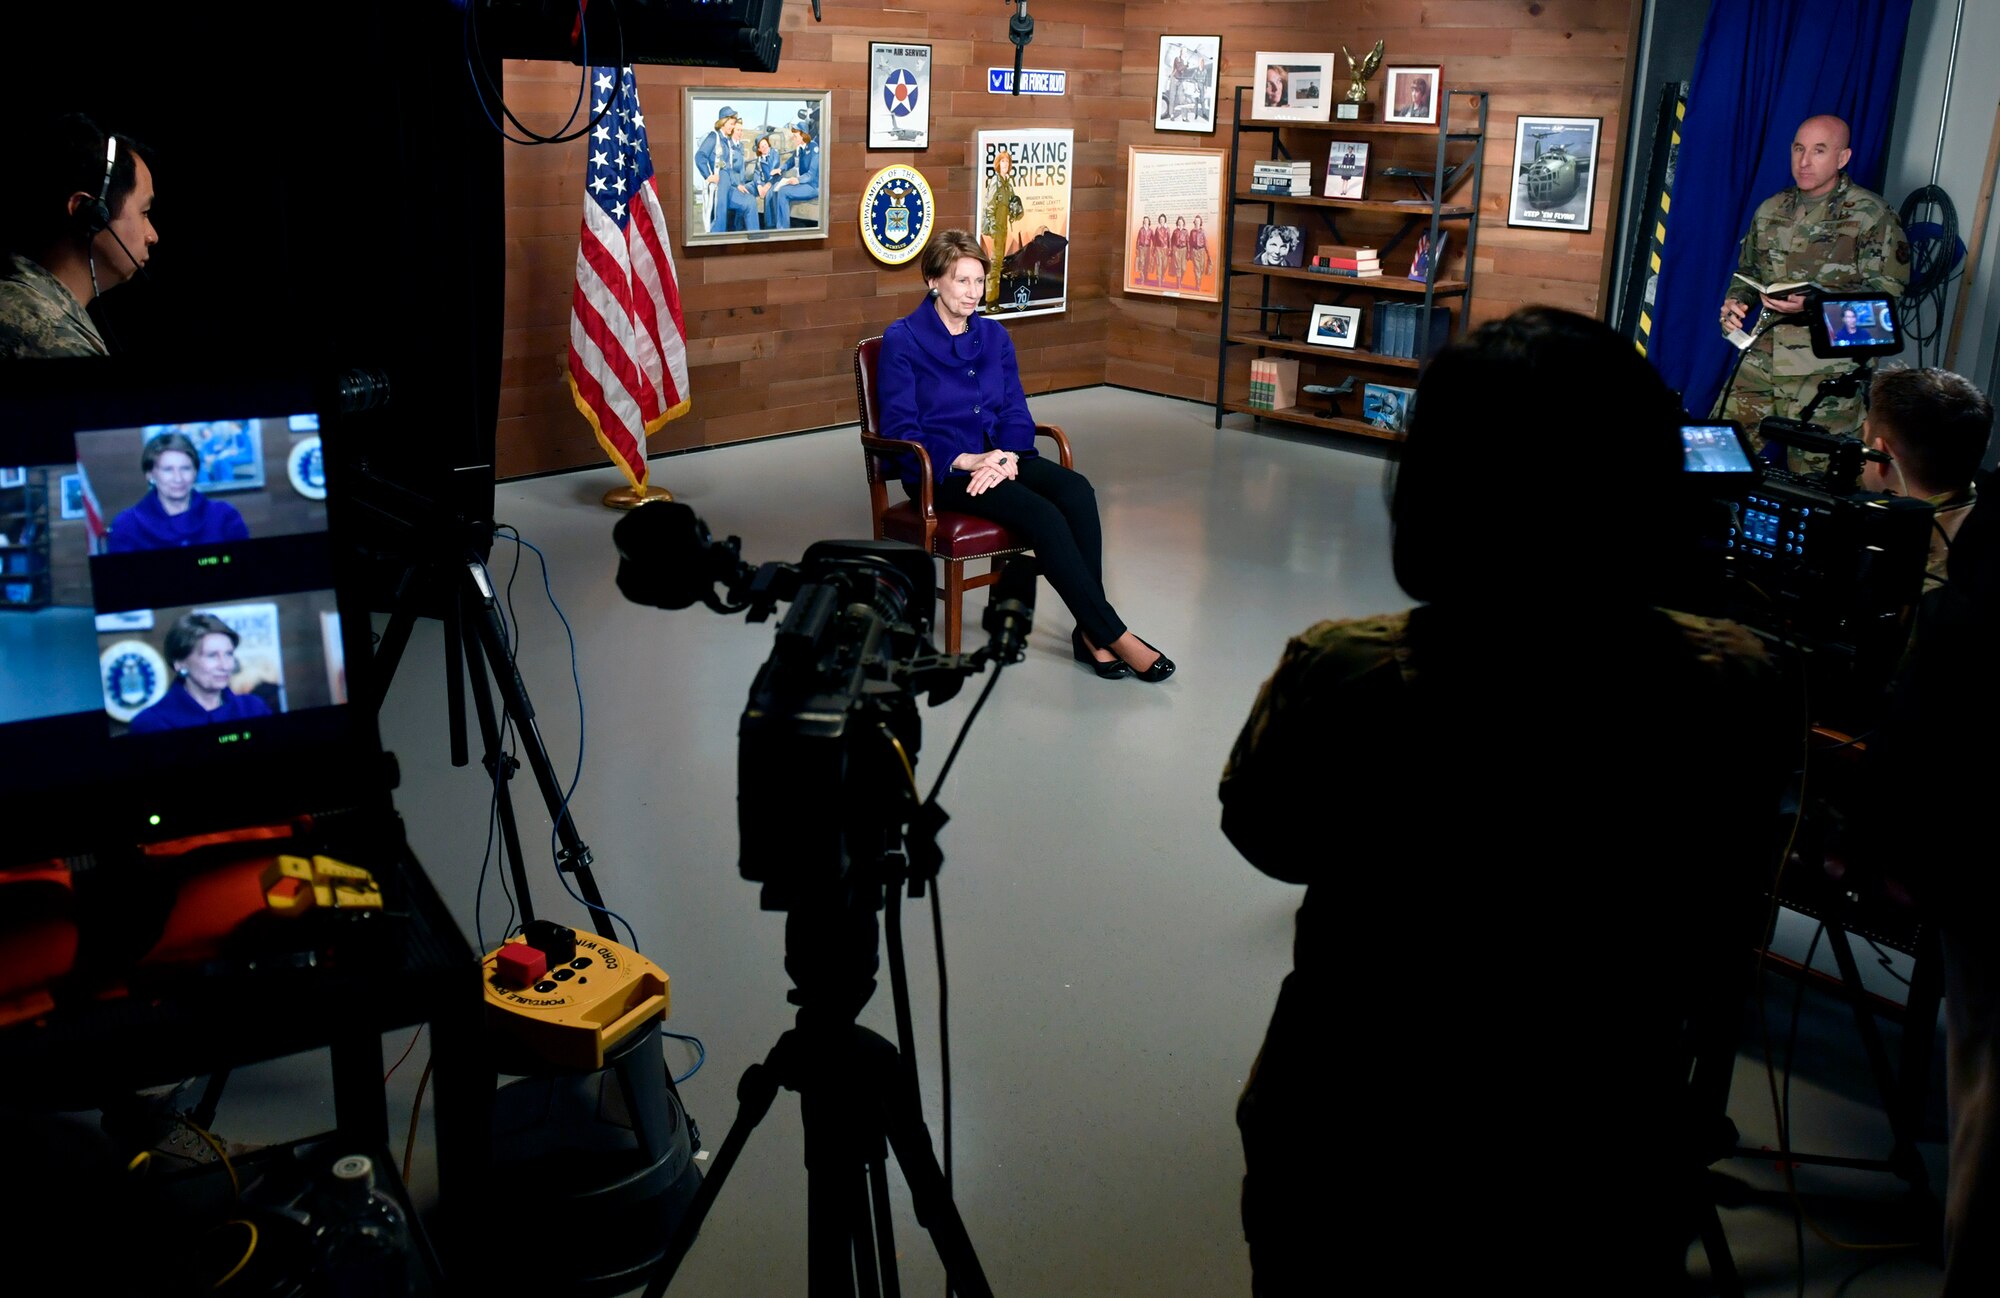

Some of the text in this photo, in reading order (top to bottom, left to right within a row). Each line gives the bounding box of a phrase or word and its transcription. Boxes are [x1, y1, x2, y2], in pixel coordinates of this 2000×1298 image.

[894, 48, 903, 56] AIR
[905, 49, 927, 57] SERVICE
[1029, 73, 1049, 91] FORCE
[1049, 74, 1063, 92] BLVD
[985, 165, 1066, 188] BRRIERS
[864, 176, 884, 231] DEPARTMENT
[888, 169, 897, 178] OF
[902, 170, 916, 181] THE
[917, 181, 927, 195] AIR
[1523, 210, 1540, 218] KEEP
[1554, 212, 1576, 221] FLYING
[883, 251, 897, 260] STATES
[1017, 293, 1027, 305] 70
[575, 939, 618, 969] CORD WIN
[507, 993, 565, 1006] PORTABLE
